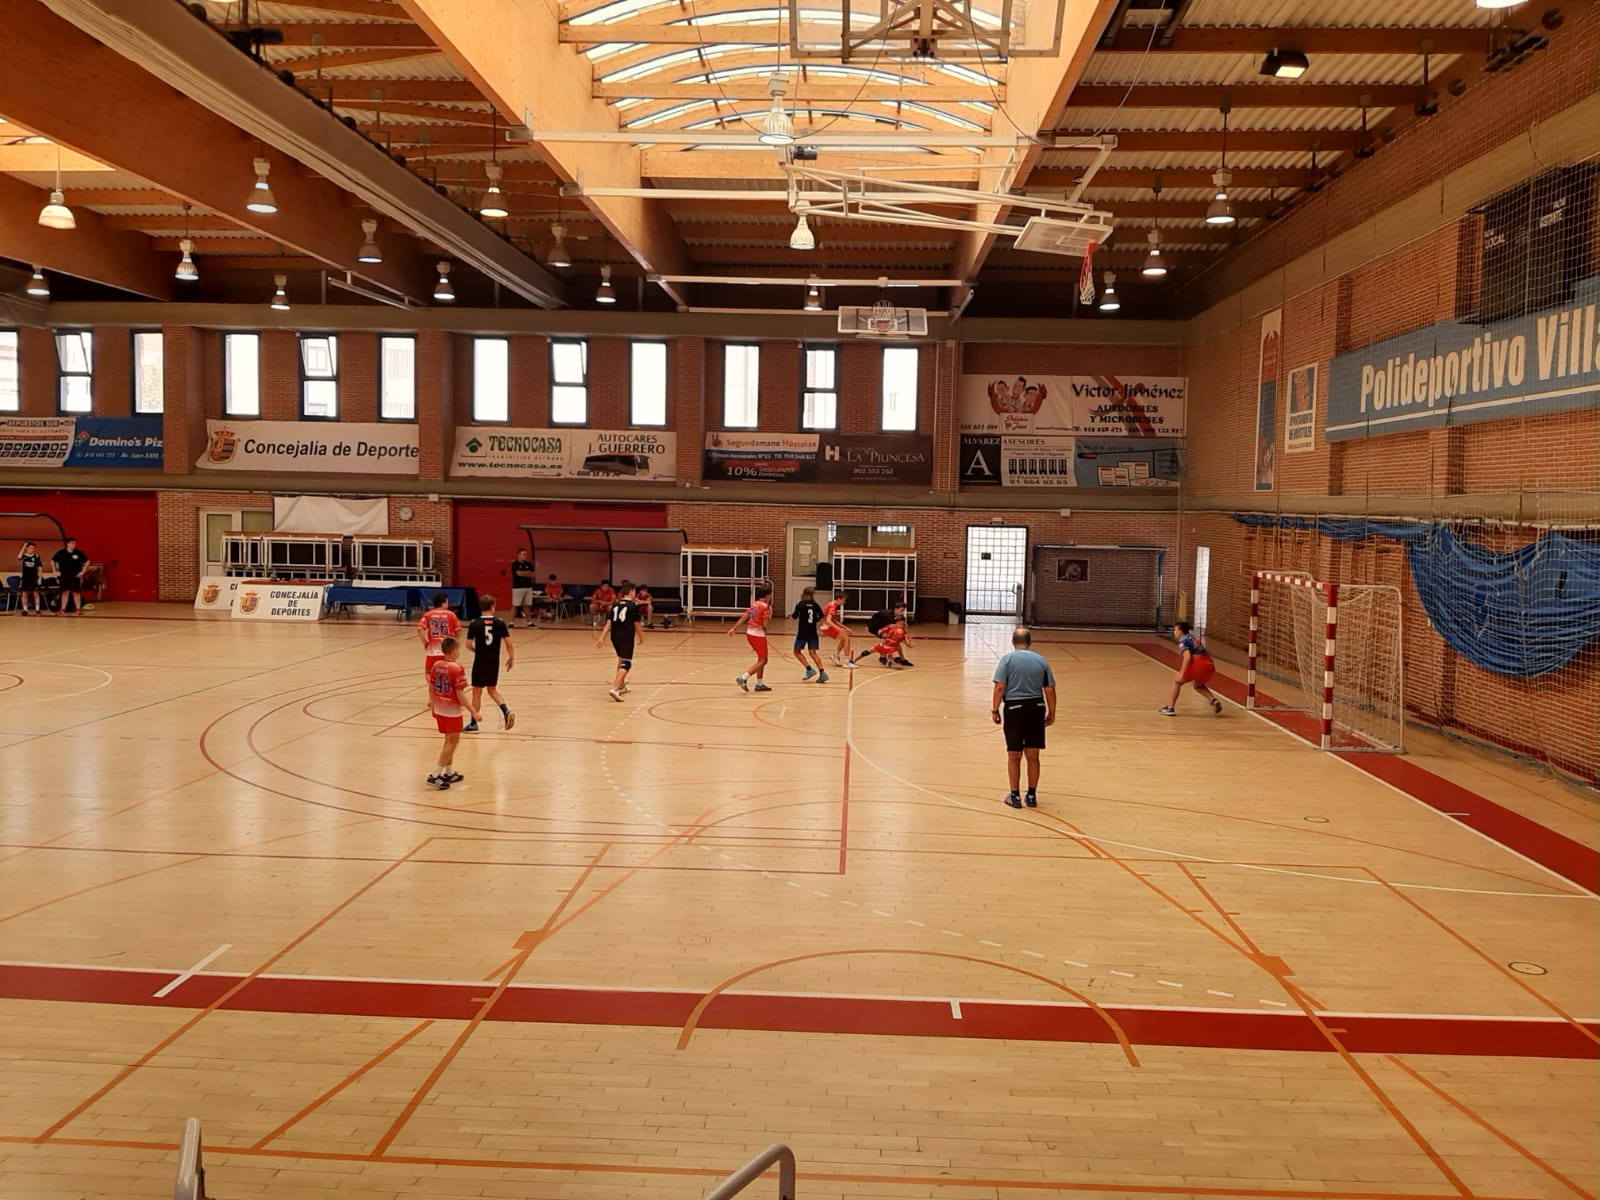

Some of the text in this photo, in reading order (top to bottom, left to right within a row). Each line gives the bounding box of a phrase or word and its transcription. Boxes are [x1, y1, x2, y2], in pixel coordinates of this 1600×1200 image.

[1360, 332, 1526, 413] Polideportivo
[1123, 383, 1184, 399] Jiménez
[1097, 404, 1159, 413] AUTOCARES
[1100, 416, 1164, 424] MICROBUSES
[89, 437, 142, 447] Domino's
[488, 435, 562, 454] TECNOCASA
[597, 433, 658, 444] AUTOCARES
[726, 439, 780, 449] Segundamano
[244, 439, 419, 459] Concejalía de Deporte
[588, 442, 666, 455] J. GUERRERO
[457, 461, 563, 469] www.tecnocasa.es
[965, 449, 994, 476] A
[726, 467, 757, 477] 10%
[270, 590, 319, 600] CONCEJALÍA
[271, 608, 312, 616] DEPORTES
[612, 606, 628, 623] 14
[807, 608, 814, 624] 3
[430, 619, 448, 636] 26
[484, 626, 494, 646] 5
